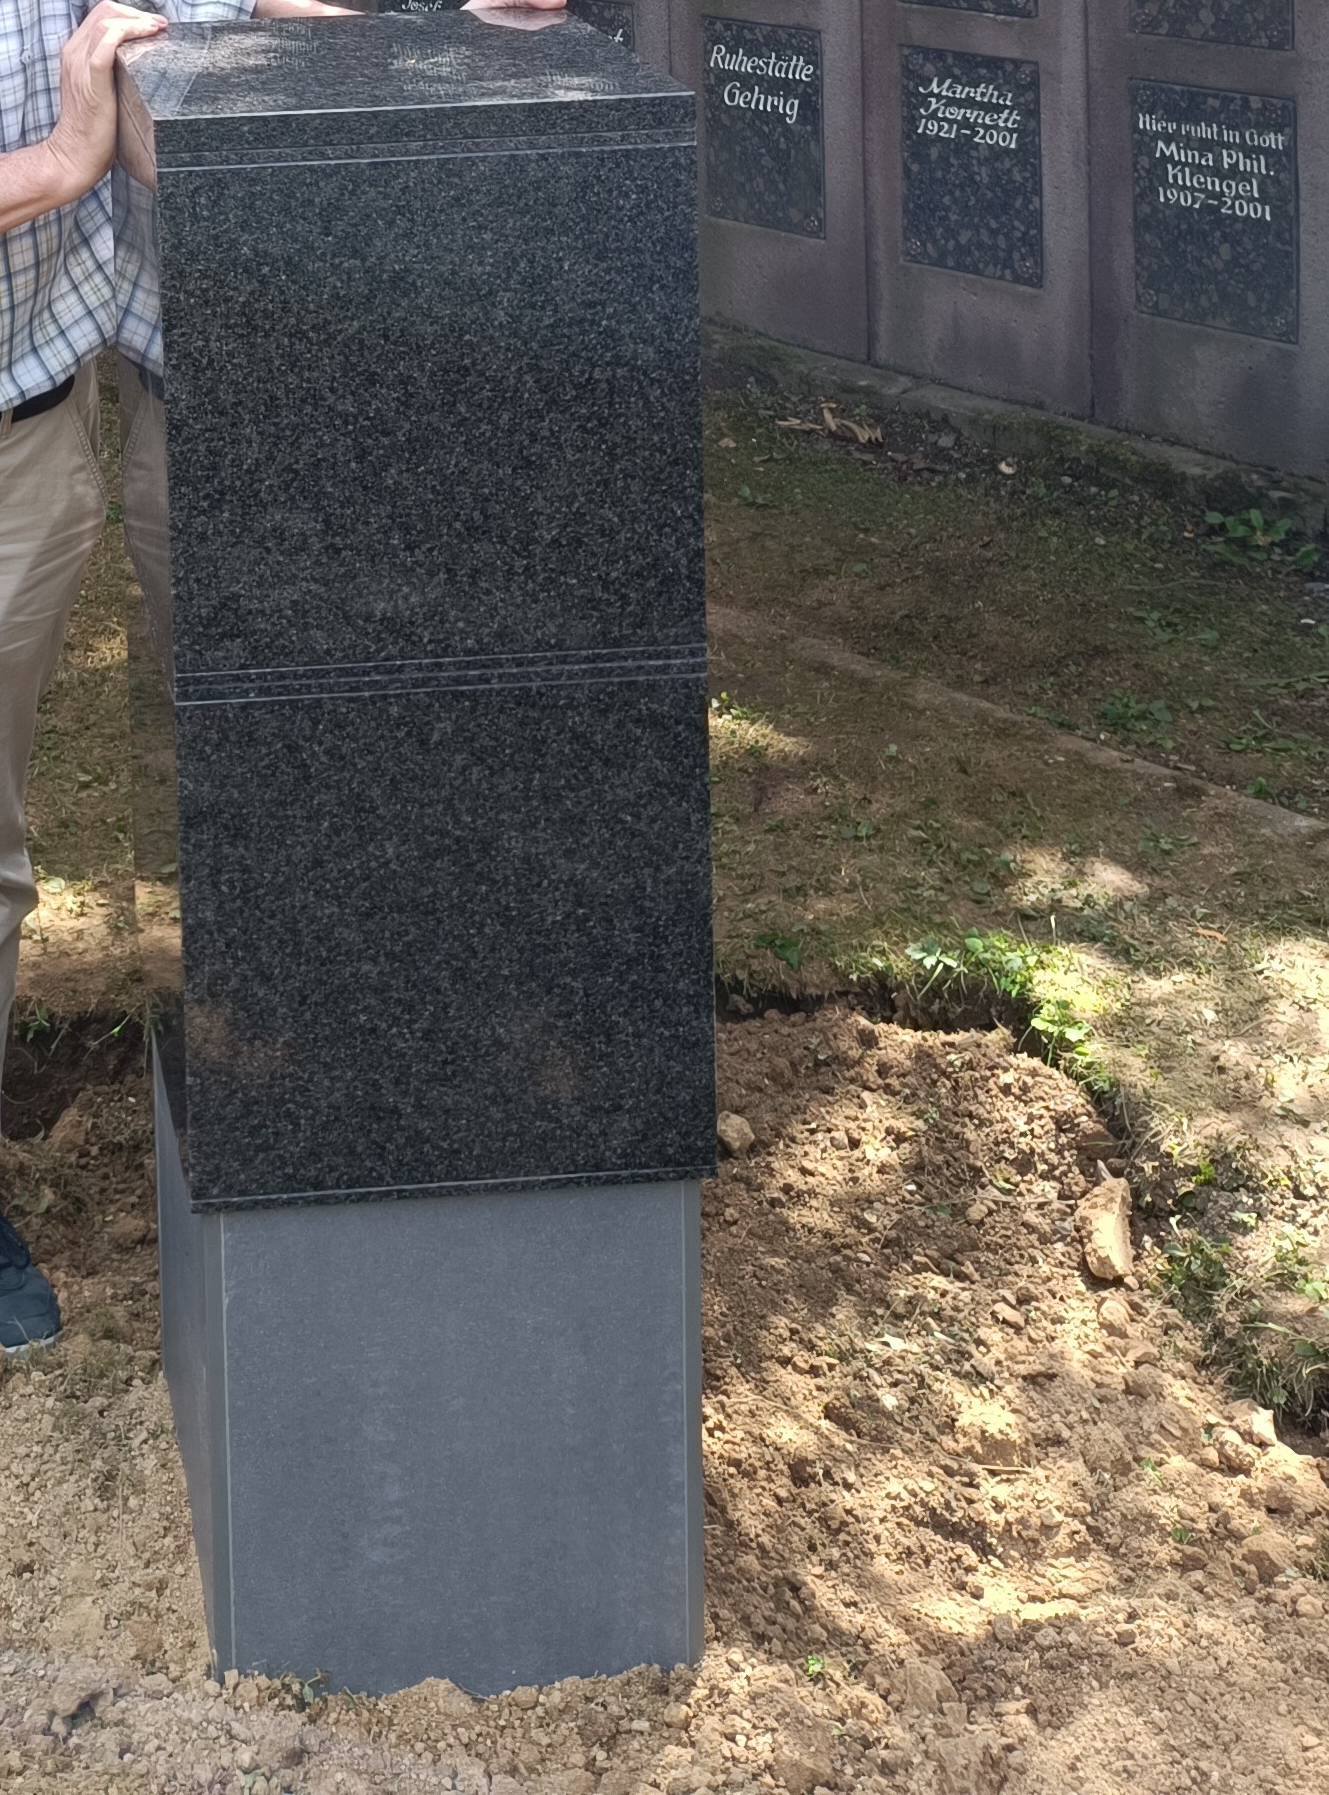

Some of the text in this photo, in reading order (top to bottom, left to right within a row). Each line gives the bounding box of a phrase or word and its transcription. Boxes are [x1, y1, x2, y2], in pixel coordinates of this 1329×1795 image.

[710, 44, 814, 82] Ruhestätte
[723, 82, 799, 124] Gehrig
[919, 77, 1013, 105] Martha
[920, 97, 1020, 128] Kornett
[917, 118, 1018, 149] 1921-2001
[1138, 113, 1285, 151] Hier ruht in Gott
[1155, 139, 1214, 166] Mina
[1167, 163, 1259, 198] Klengel
[1159, 186, 1271, 221] 1907-2001
